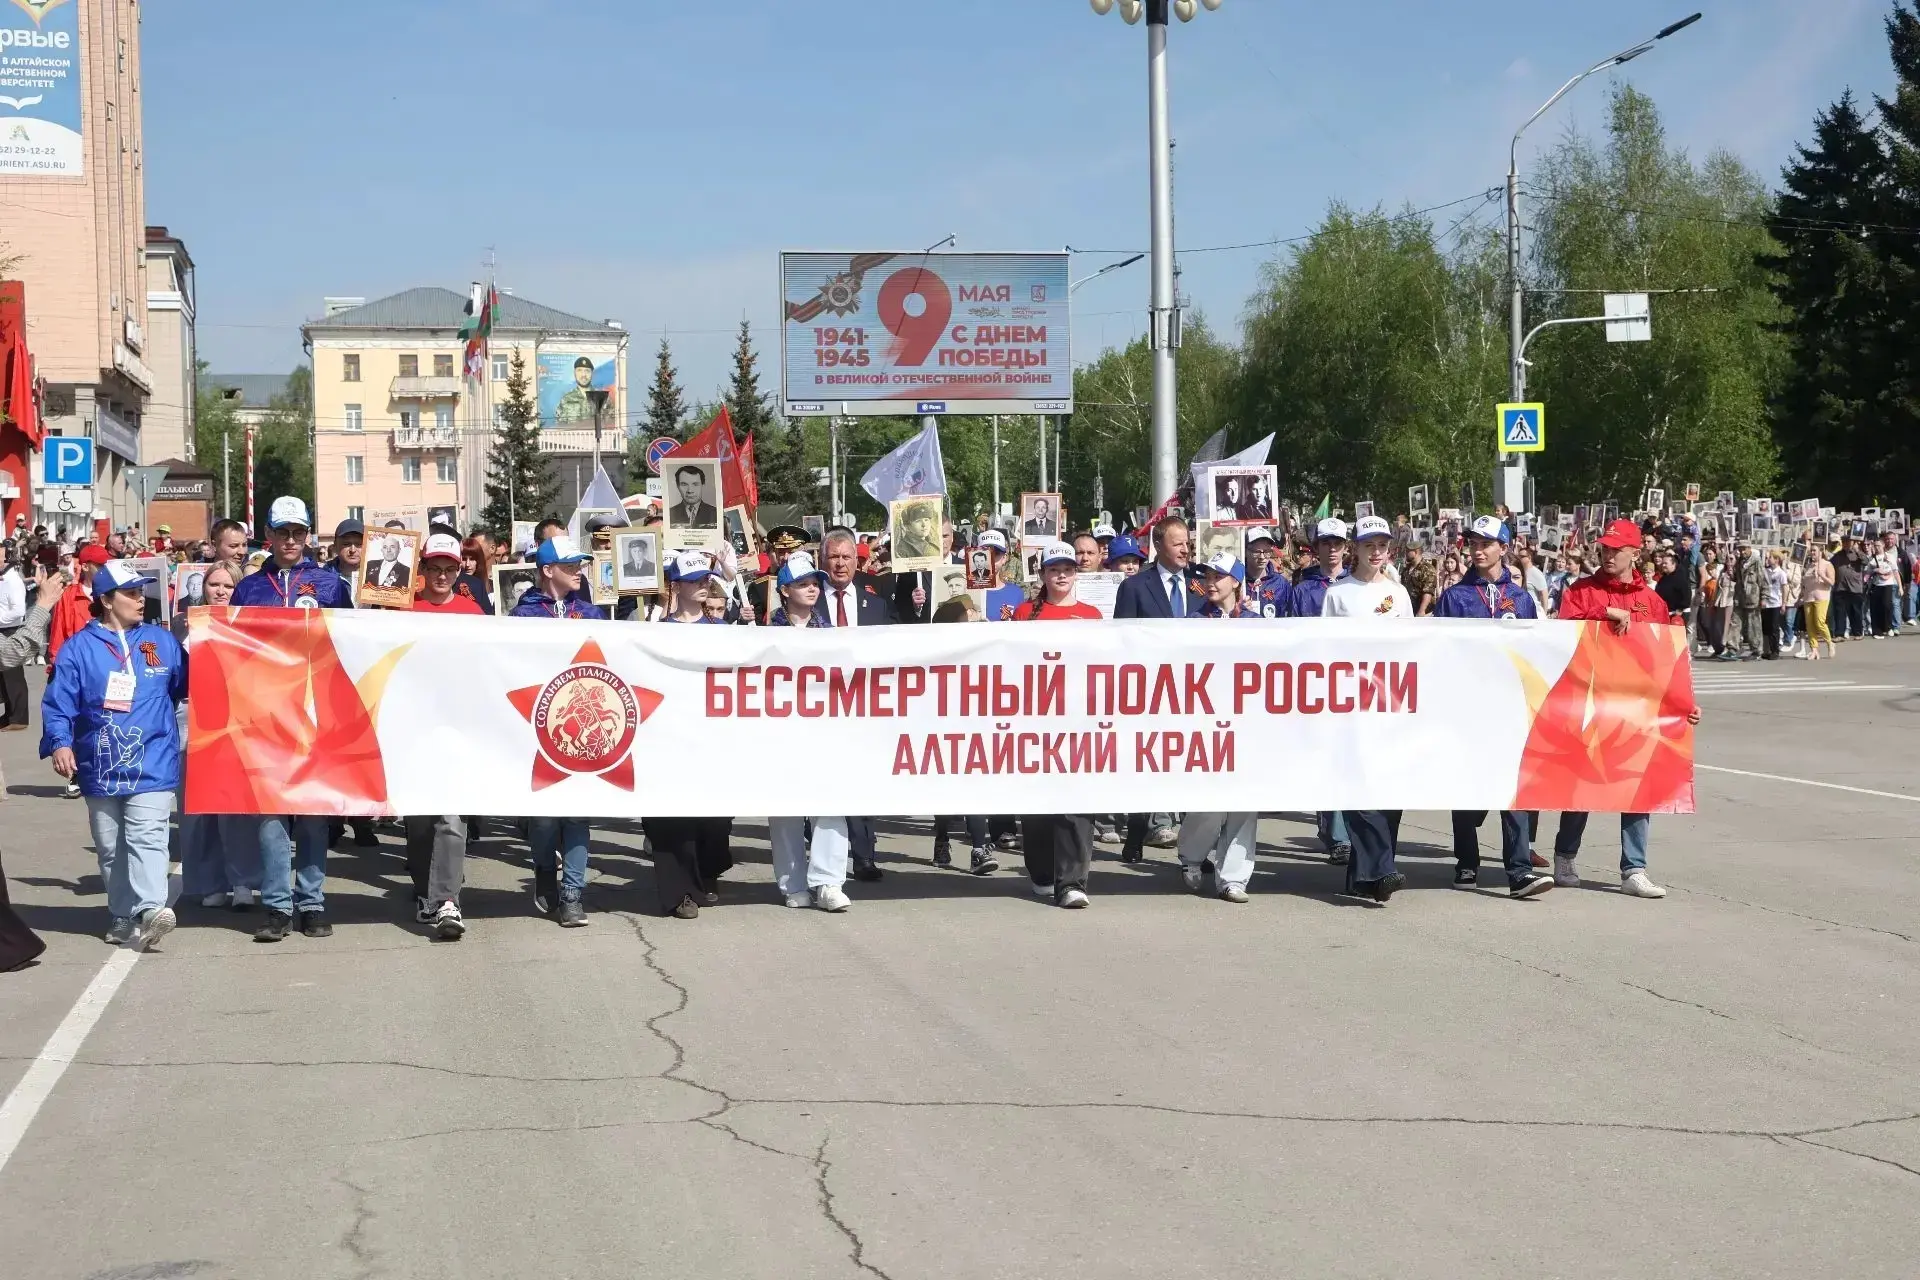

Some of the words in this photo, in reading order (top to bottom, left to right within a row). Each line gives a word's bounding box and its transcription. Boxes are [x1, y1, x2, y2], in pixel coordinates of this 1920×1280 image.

[11, 56, 70, 67] АЛТАЙСКОМ
[0, 68, 66, 78] АРСТВЕННОМ
[1, 79, 55, 88] ВЕРСИТЕТЕ
[15, 147, 56, 155] 29-12-22
[877, 267, 952, 366] 9
[959, 284, 1010, 302] МАЯ
[814, 327, 869, 346] 1941-
[952, 325, 968, 343] С
[973, 325, 1047, 346] ДНЕМ
[814, 349, 870, 367] 1945
[939, 349, 1047, 369] ПОБЕДЫ
[815, 375, 822, 384] В
[827, 372, 888, 384] ВЕЛИКОЙ
[893, 372, 1001, 384] ОТЕЧЕСТВЕННОЙ
[1005, 372, 1052, 384] ВОЙНЕ!
[58, 442, 84, 479] P
[705, 652, 1066, 717] БЕССМЕРТНЫЙ
[1087, 663, 1215, 715] ПОЛК
[1233, 662, 1418, 714] РОССИИ
[536, 670, 576, 728] СОХРАНЯЕМ
[578, 667, 618, 688] ПАМЯТЬ
[619, 687, 635, 729] ВМЕСТЕ
[892, 721, 1117, 775] АЛТАЙСКИЙ
[1136, 721, 1235, 773] КРАЙ
